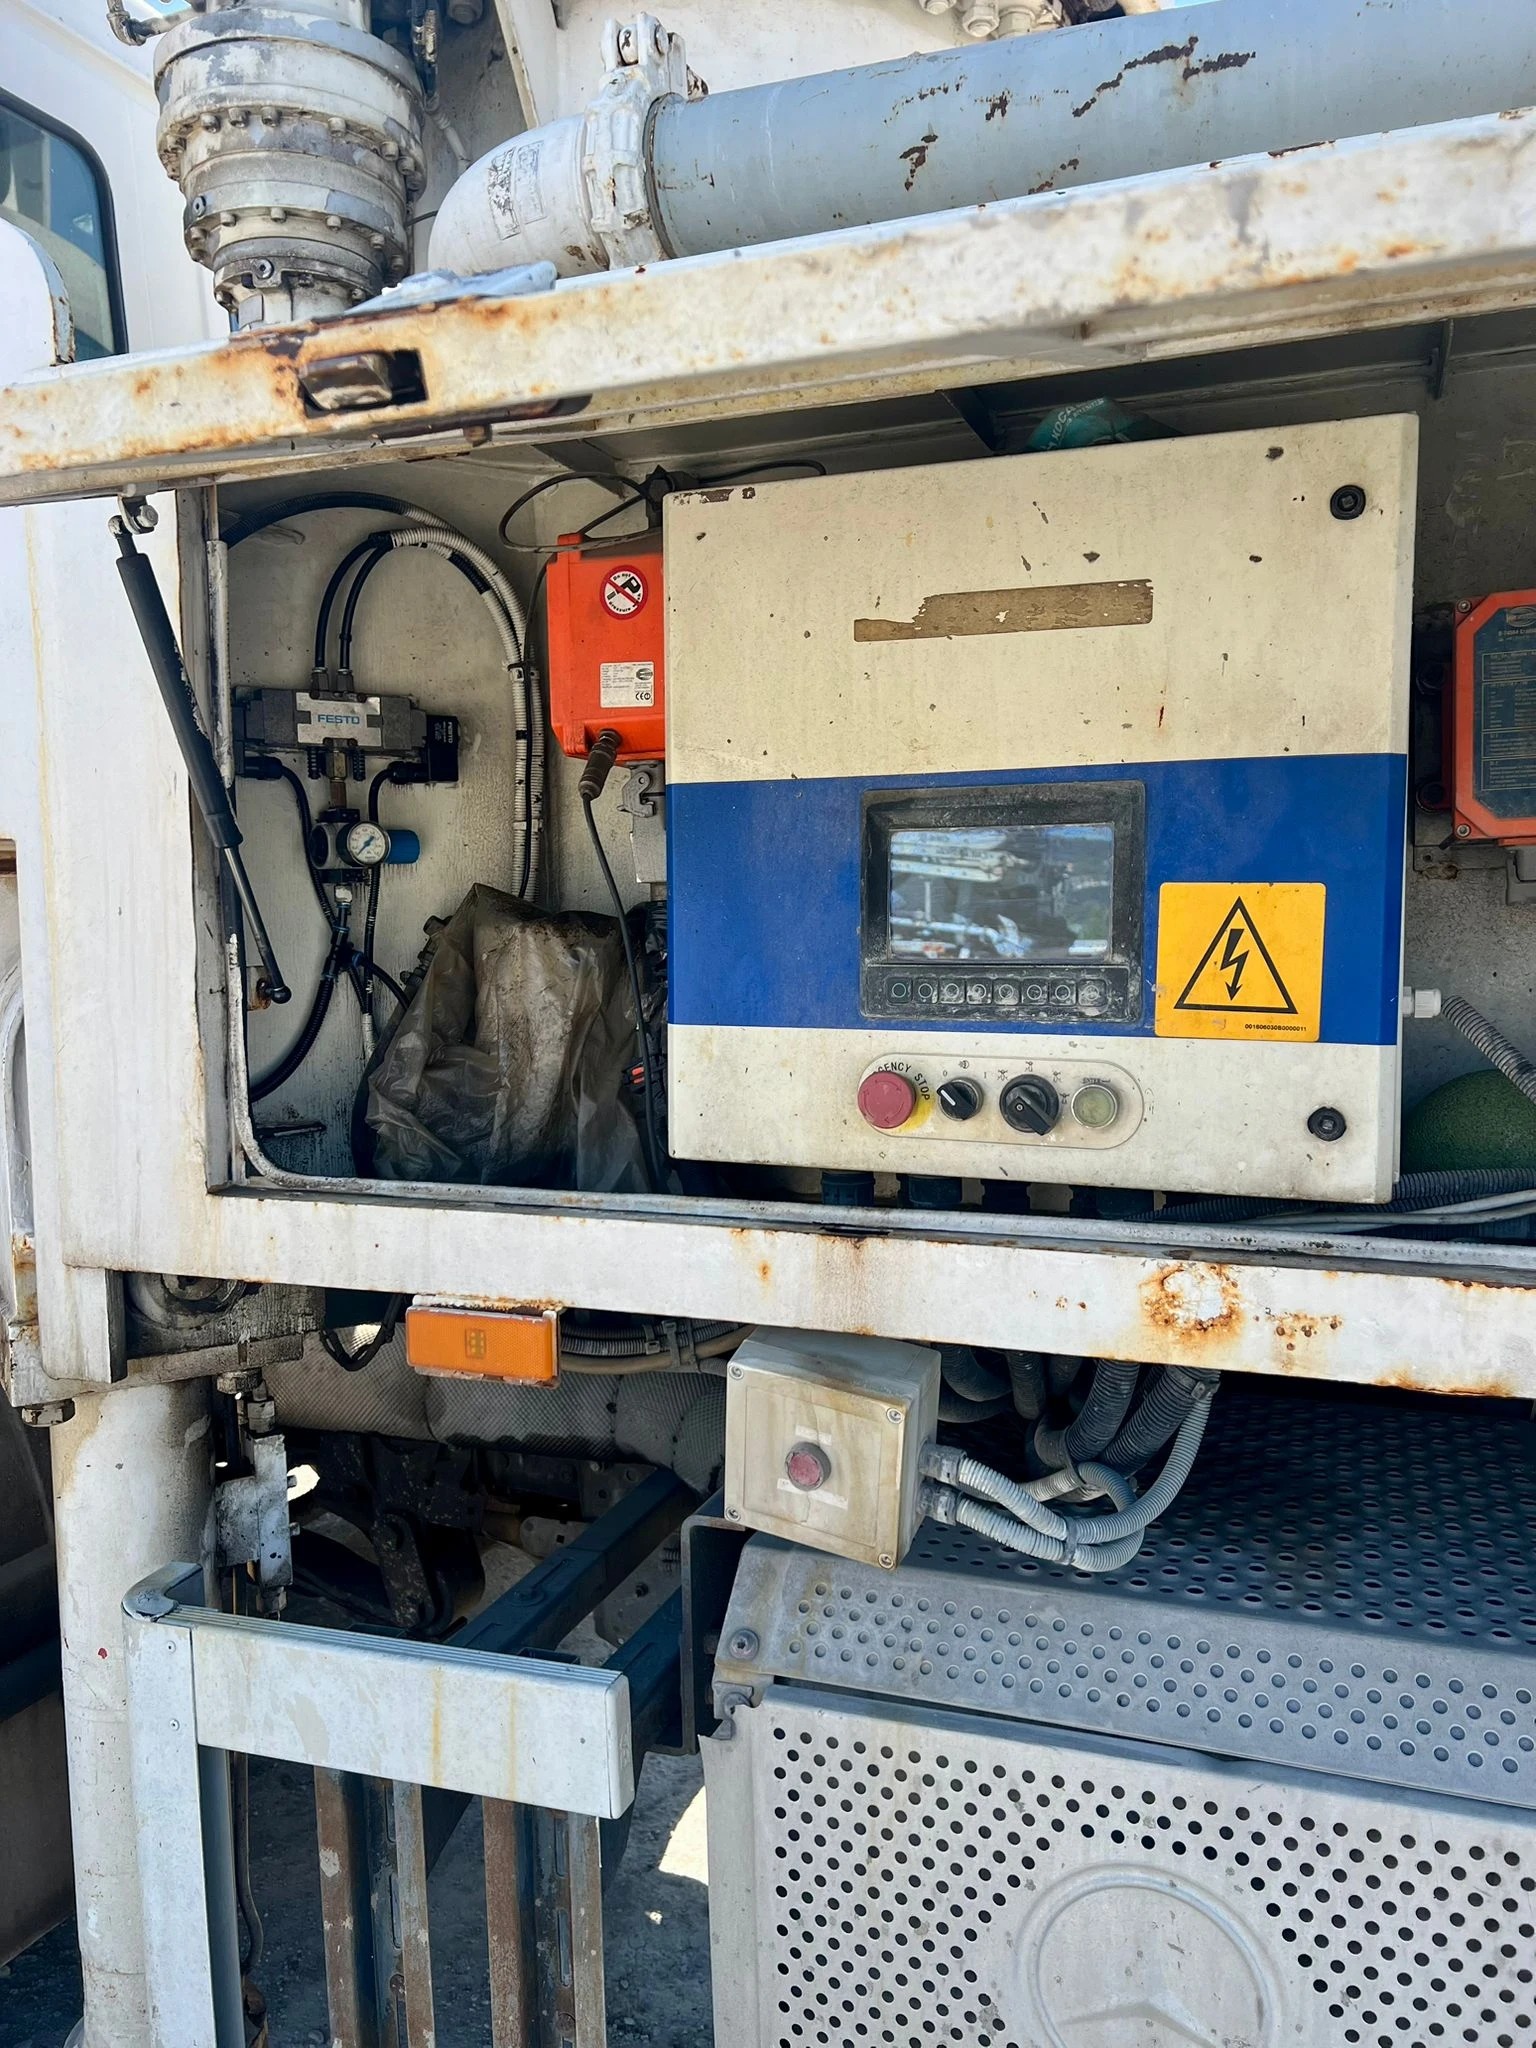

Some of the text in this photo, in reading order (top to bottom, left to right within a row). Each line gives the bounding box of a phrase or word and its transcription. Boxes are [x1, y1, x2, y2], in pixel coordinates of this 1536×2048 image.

[317, 714, 360, 725] FESTO
[877, 1061, 931, 1101] GENCY STOP
